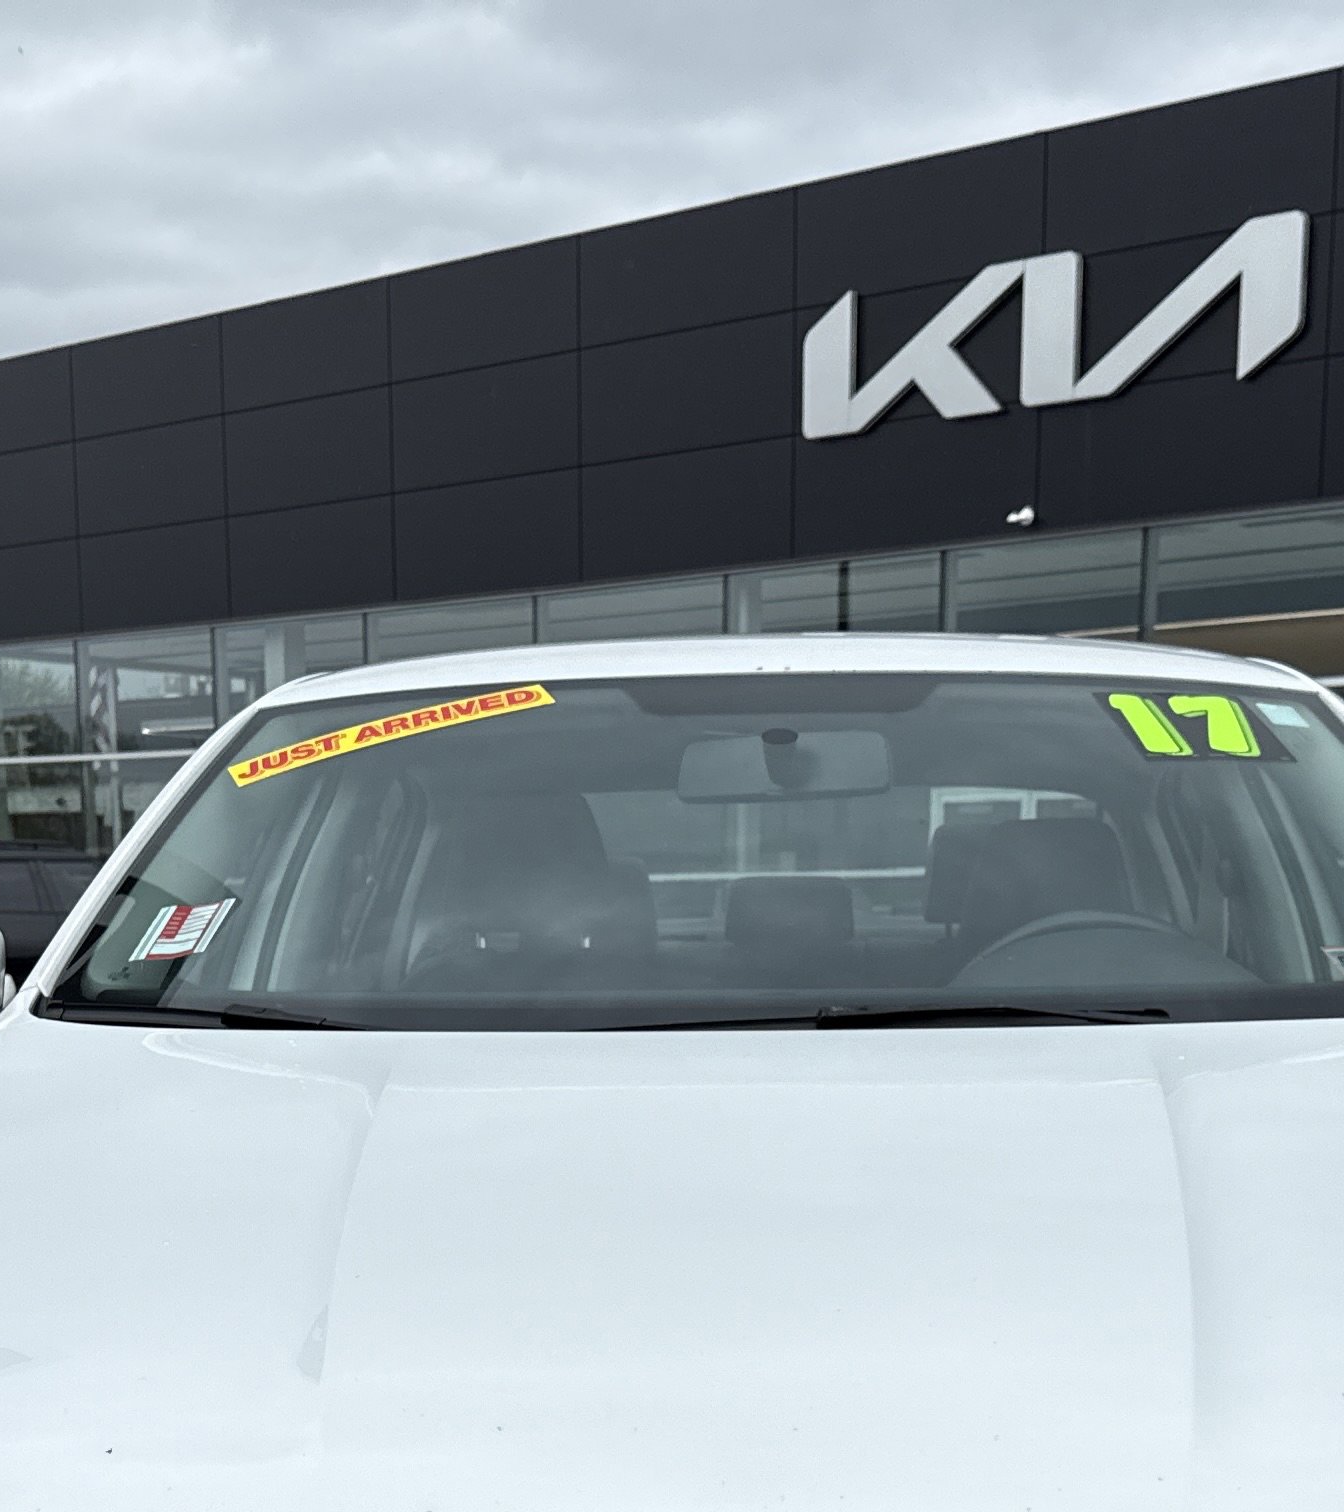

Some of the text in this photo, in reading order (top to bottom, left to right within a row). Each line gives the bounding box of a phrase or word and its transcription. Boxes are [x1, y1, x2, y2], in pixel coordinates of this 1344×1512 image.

[803, 209, 1310, 439] KIA
[238, 690, 541, 779] JUST ARRIVED
[1109, 694, 1260, 757] 17
